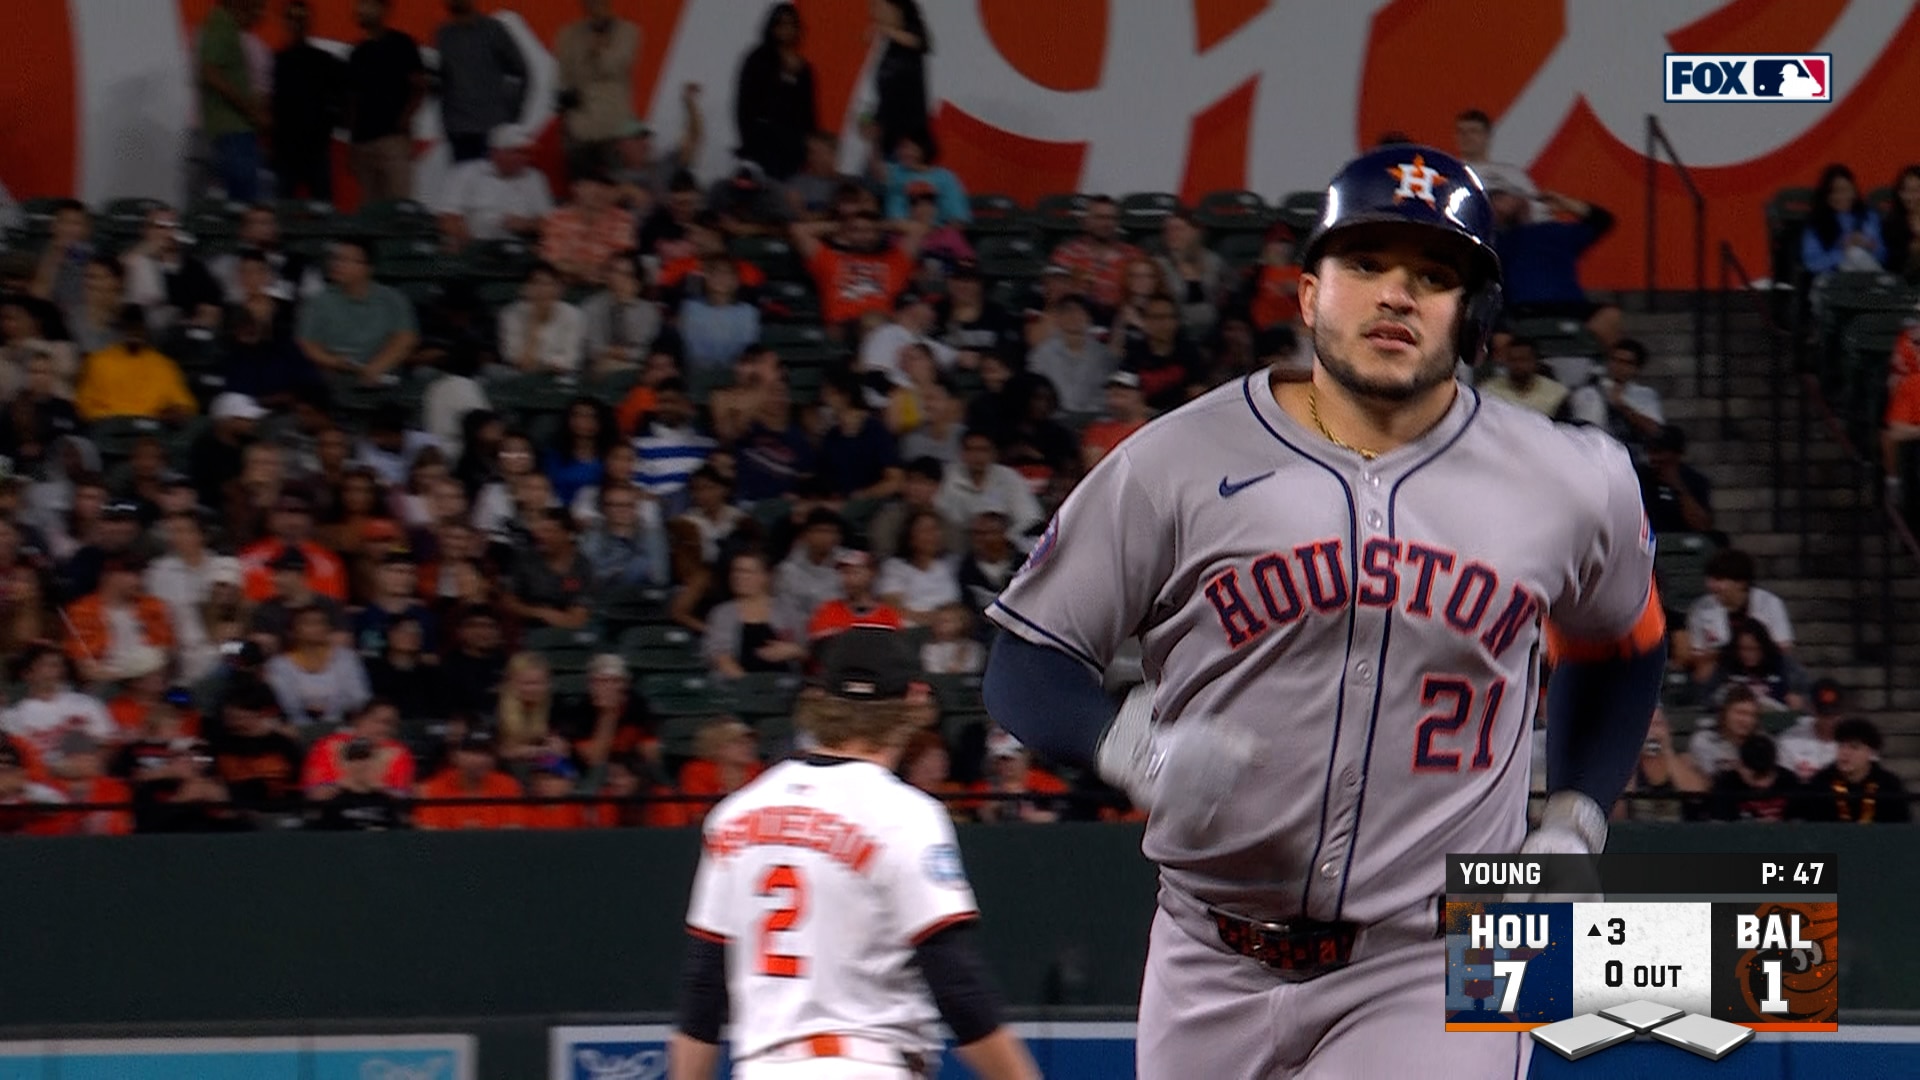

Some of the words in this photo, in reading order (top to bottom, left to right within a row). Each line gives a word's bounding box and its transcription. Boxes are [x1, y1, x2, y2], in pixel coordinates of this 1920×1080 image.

[1394, 162, 1442, 202] H
[1204, 537, 1540, 660] HOUSTON
[1411, 672, 1507, 774] 21
[757, 865, 810, 979] 2
